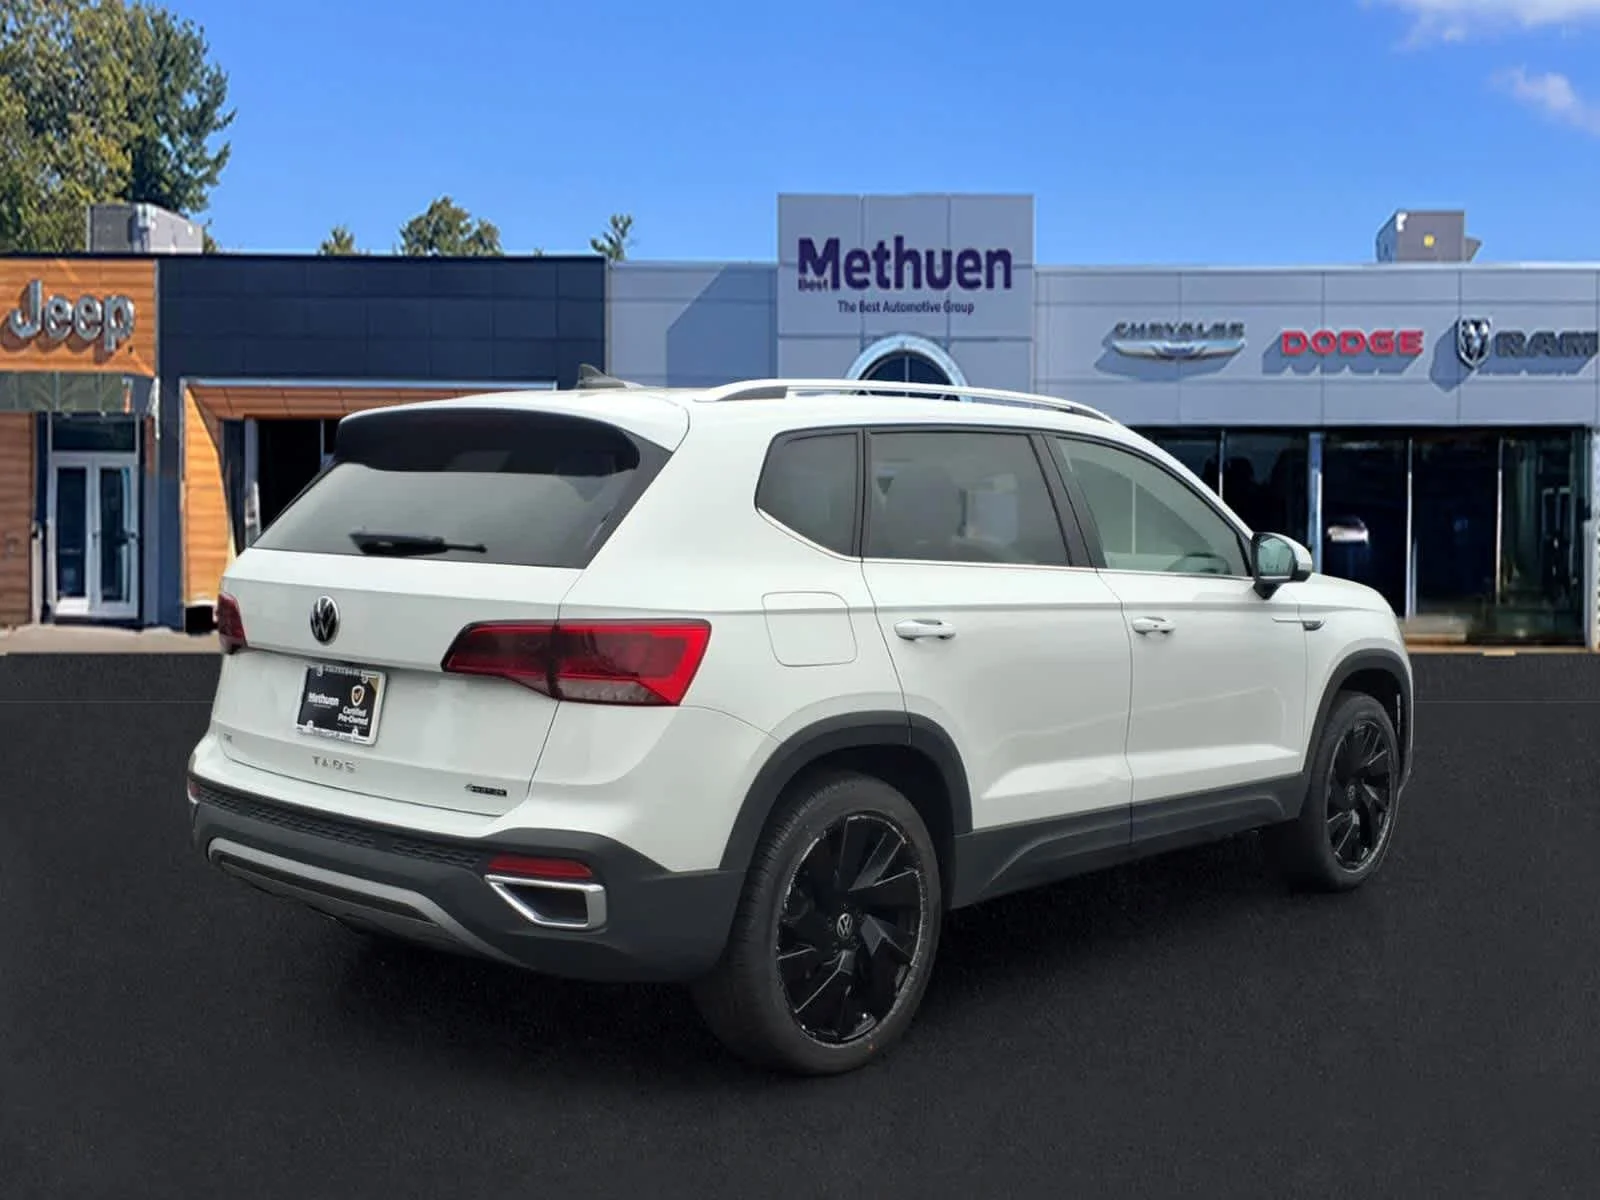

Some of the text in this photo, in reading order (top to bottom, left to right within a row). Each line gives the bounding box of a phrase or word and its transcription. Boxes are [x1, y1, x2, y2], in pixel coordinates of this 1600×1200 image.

[798, 235, 1012, 290] Methuen
[798, 278, 828, 292] Best
[9, 280, 135, 352] Jeep
[838, 300, 974, 315] The Best Automotive Group
[1114, 322, 1245, 339] CHRYSLER
[1281, 329, 1424, 355] DODGE
[1494, 331, 1599, 358] RAM
